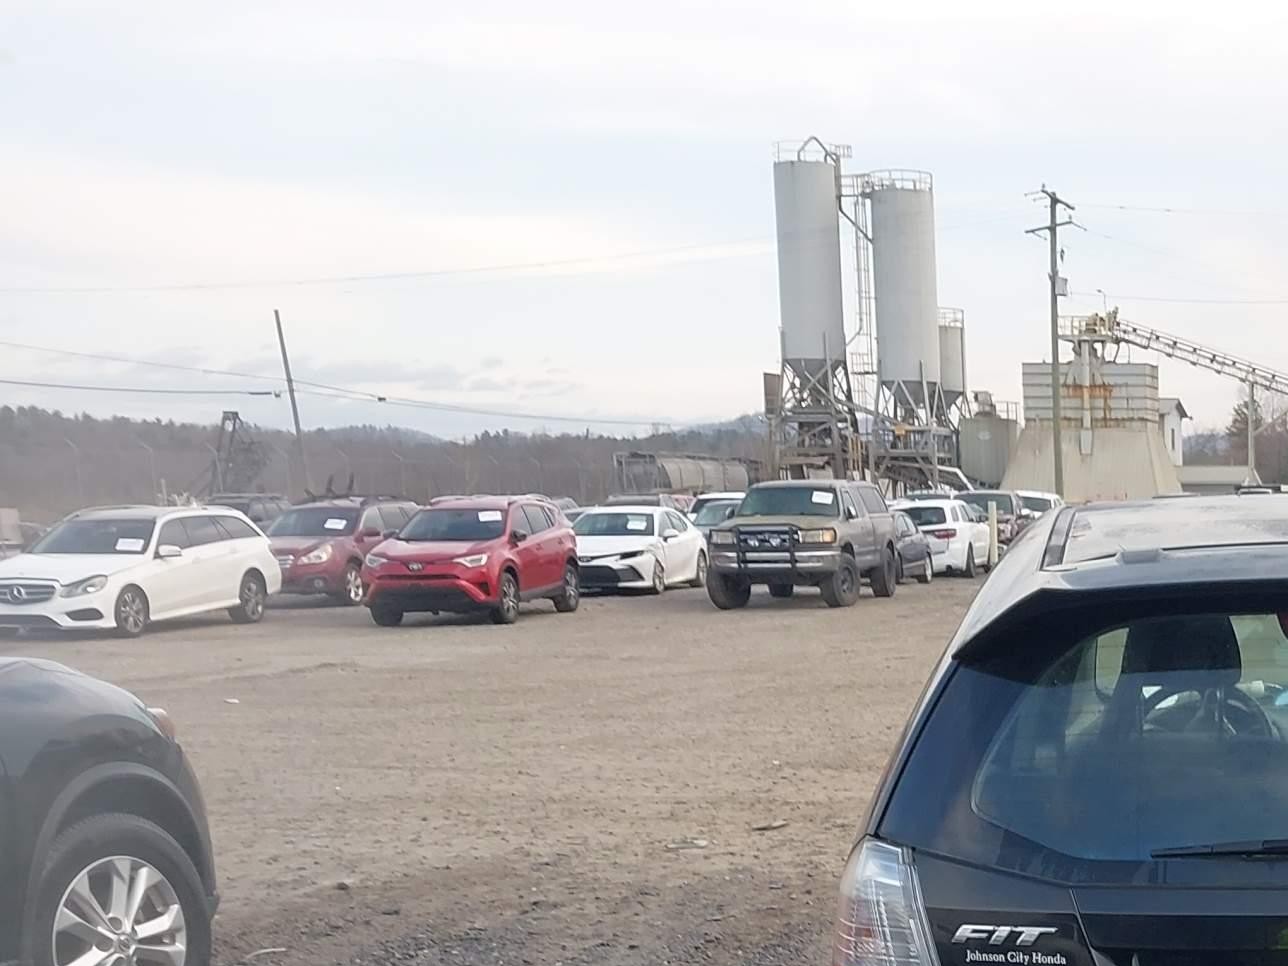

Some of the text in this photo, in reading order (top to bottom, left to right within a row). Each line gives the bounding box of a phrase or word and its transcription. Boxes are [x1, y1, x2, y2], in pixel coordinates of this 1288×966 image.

[951, 924, 1058, 946] FIT
[965, 949, 1067, 966] Johnson City Honda
